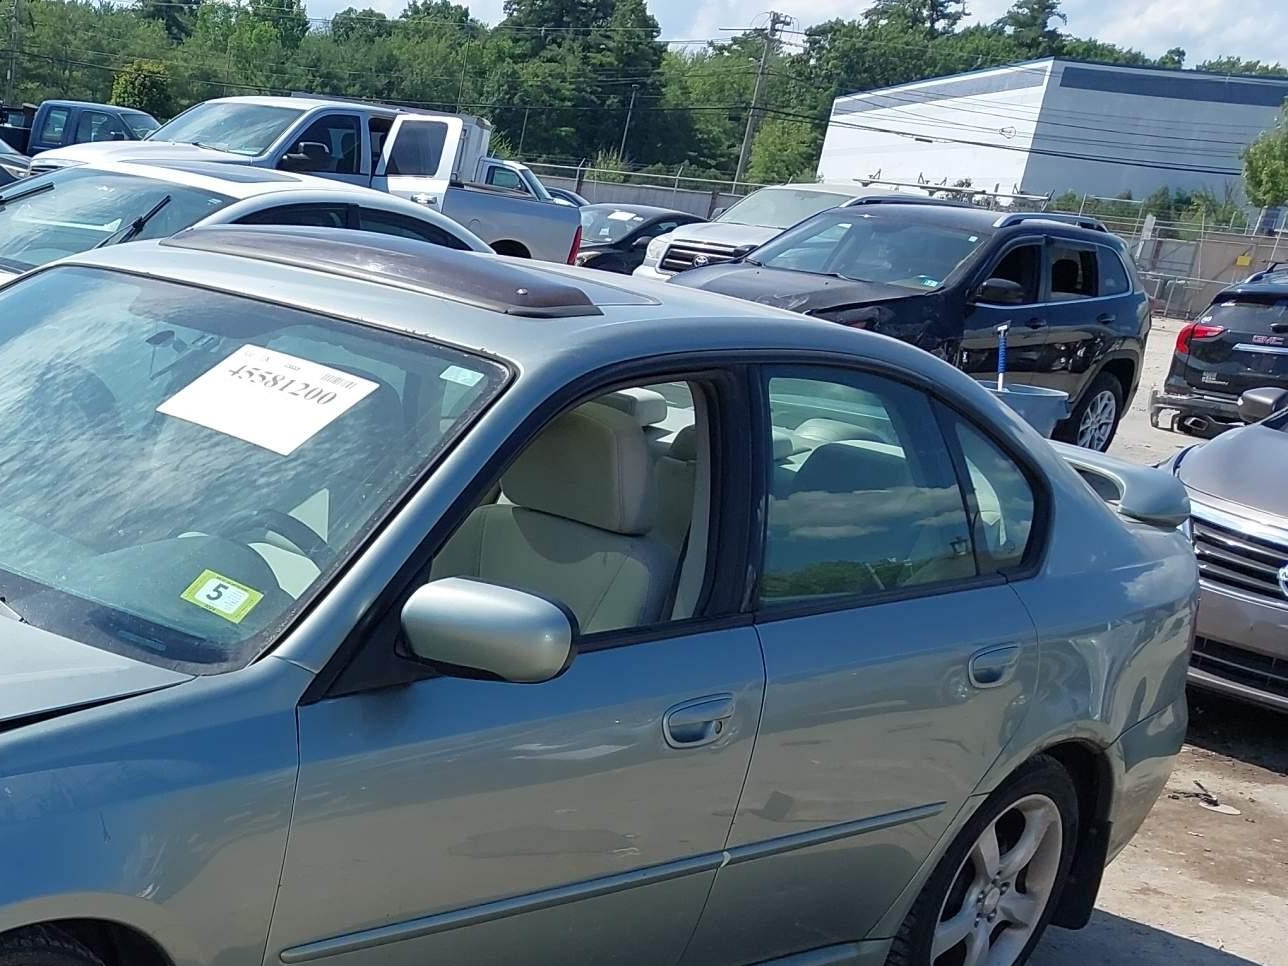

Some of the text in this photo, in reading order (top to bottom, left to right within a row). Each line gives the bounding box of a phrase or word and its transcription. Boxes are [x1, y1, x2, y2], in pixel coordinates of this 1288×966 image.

[1253, 335, 1284, 345] GMC
[228, 365, 337, 405] 45581200
[206, 583, 229, 601] 5
